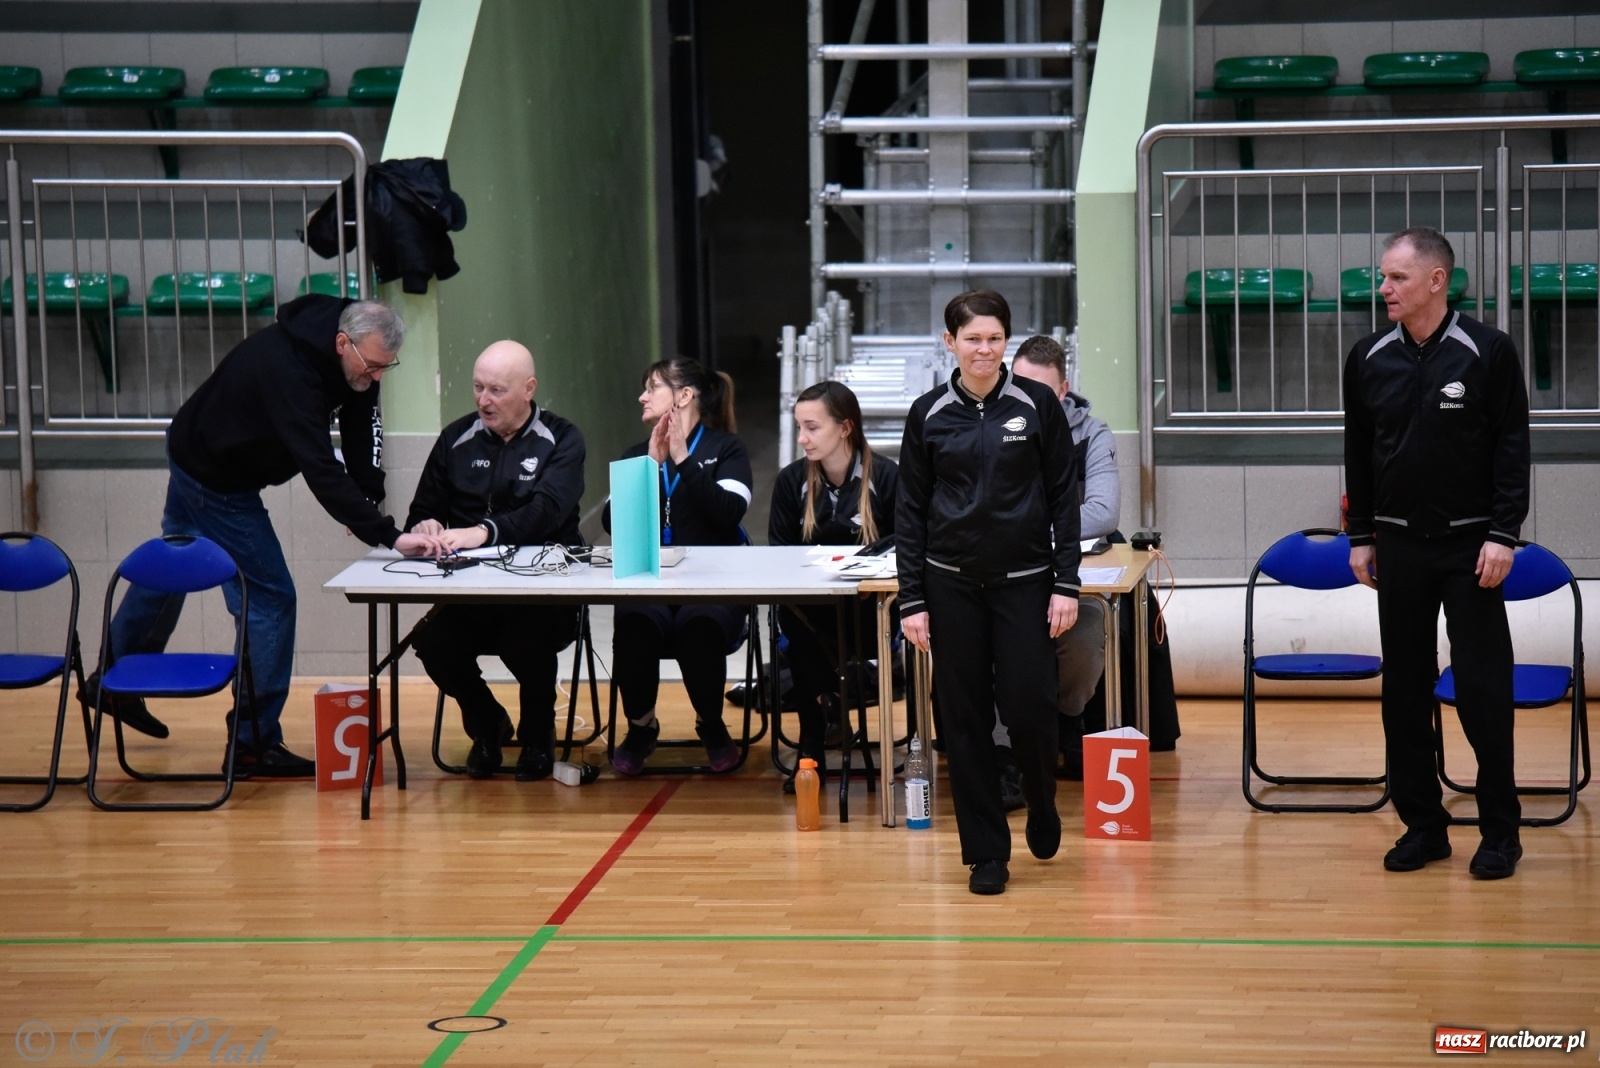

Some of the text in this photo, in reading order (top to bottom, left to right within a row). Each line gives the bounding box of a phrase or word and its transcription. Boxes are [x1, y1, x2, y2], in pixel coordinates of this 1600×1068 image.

[331, 714, 370, 781] 5
[922, 783, 930, 817] OSHEE
[1096, 748, 1138, 814] 5
